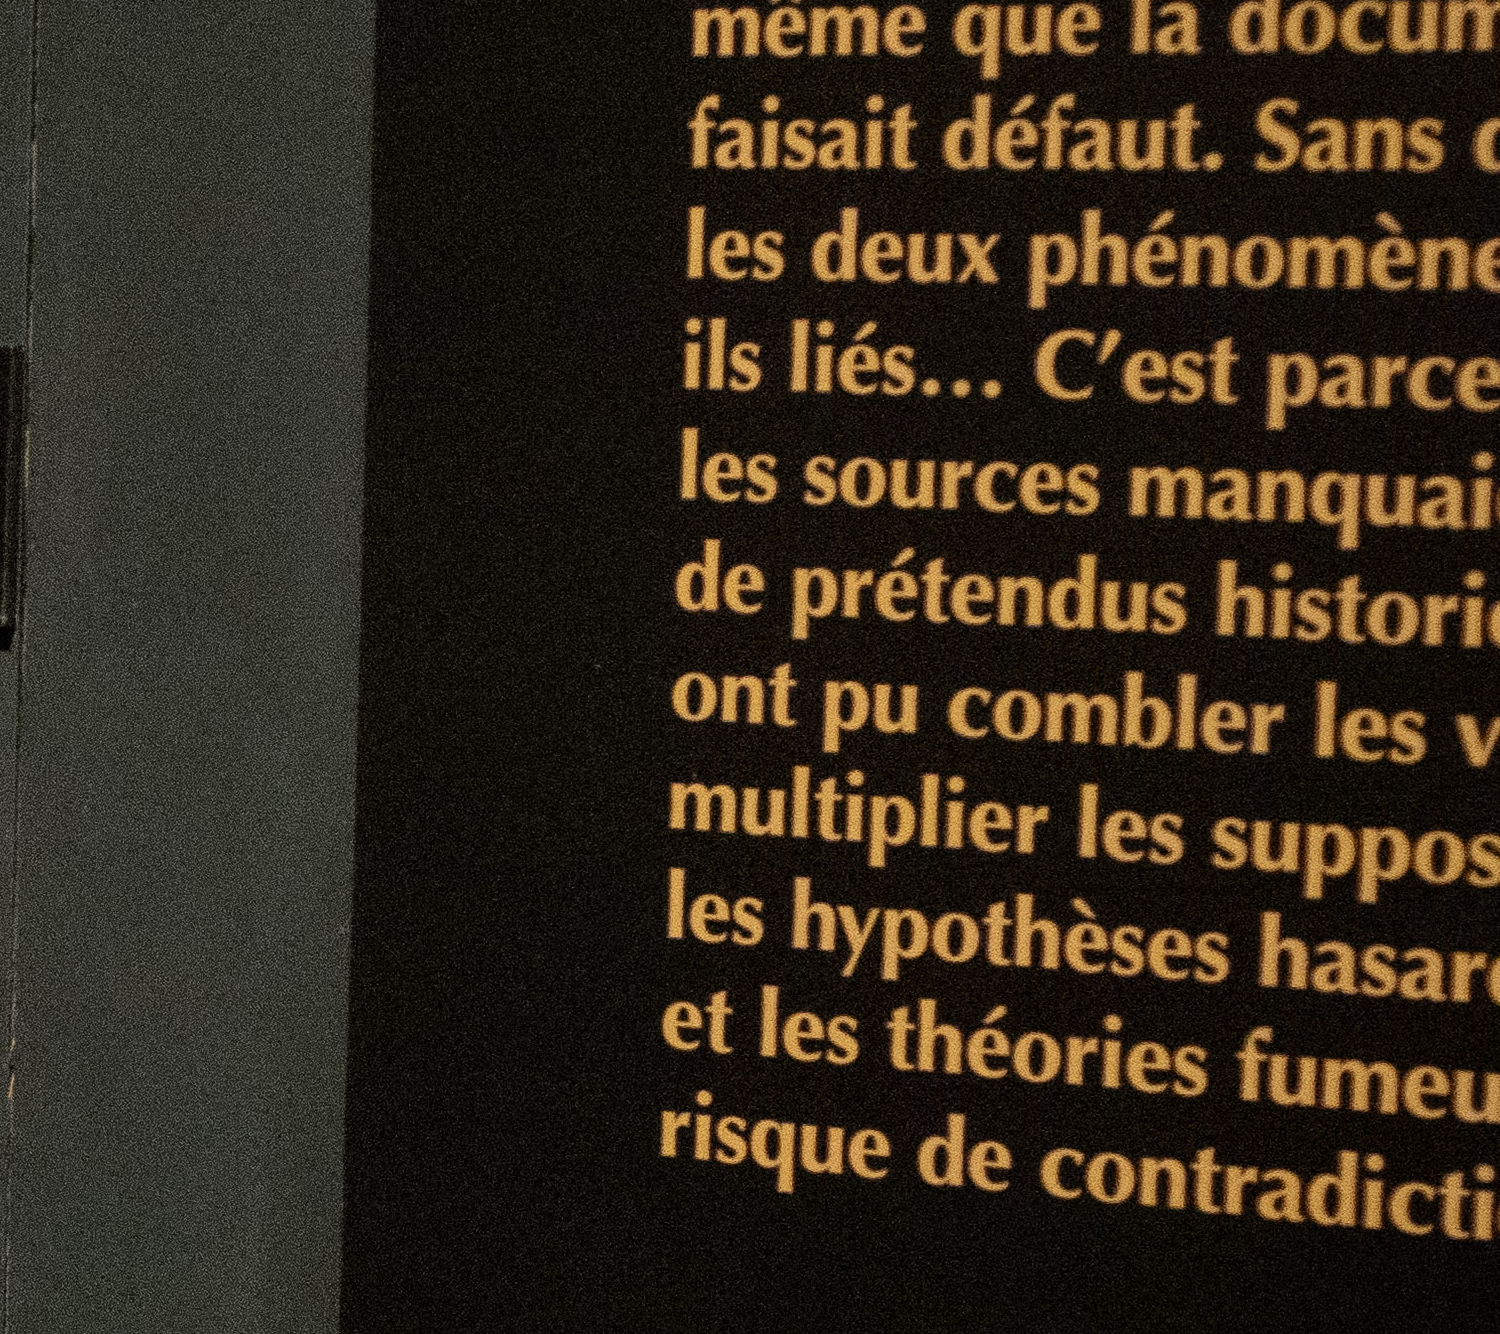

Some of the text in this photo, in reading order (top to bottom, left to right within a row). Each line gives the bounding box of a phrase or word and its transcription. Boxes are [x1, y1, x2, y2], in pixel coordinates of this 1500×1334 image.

[953, 3, 1101, 79] que
[689, 94, 917, 170] faisait
[943, 94, 1222, 171] défaut.
[1255, 98, 1444, 172] Sans
[687, 206, 785, 281] les
[812, 207, 999, 283] deux
[684, 318, 762, 392] ils
[1267, 353, 1500, 430] parce
